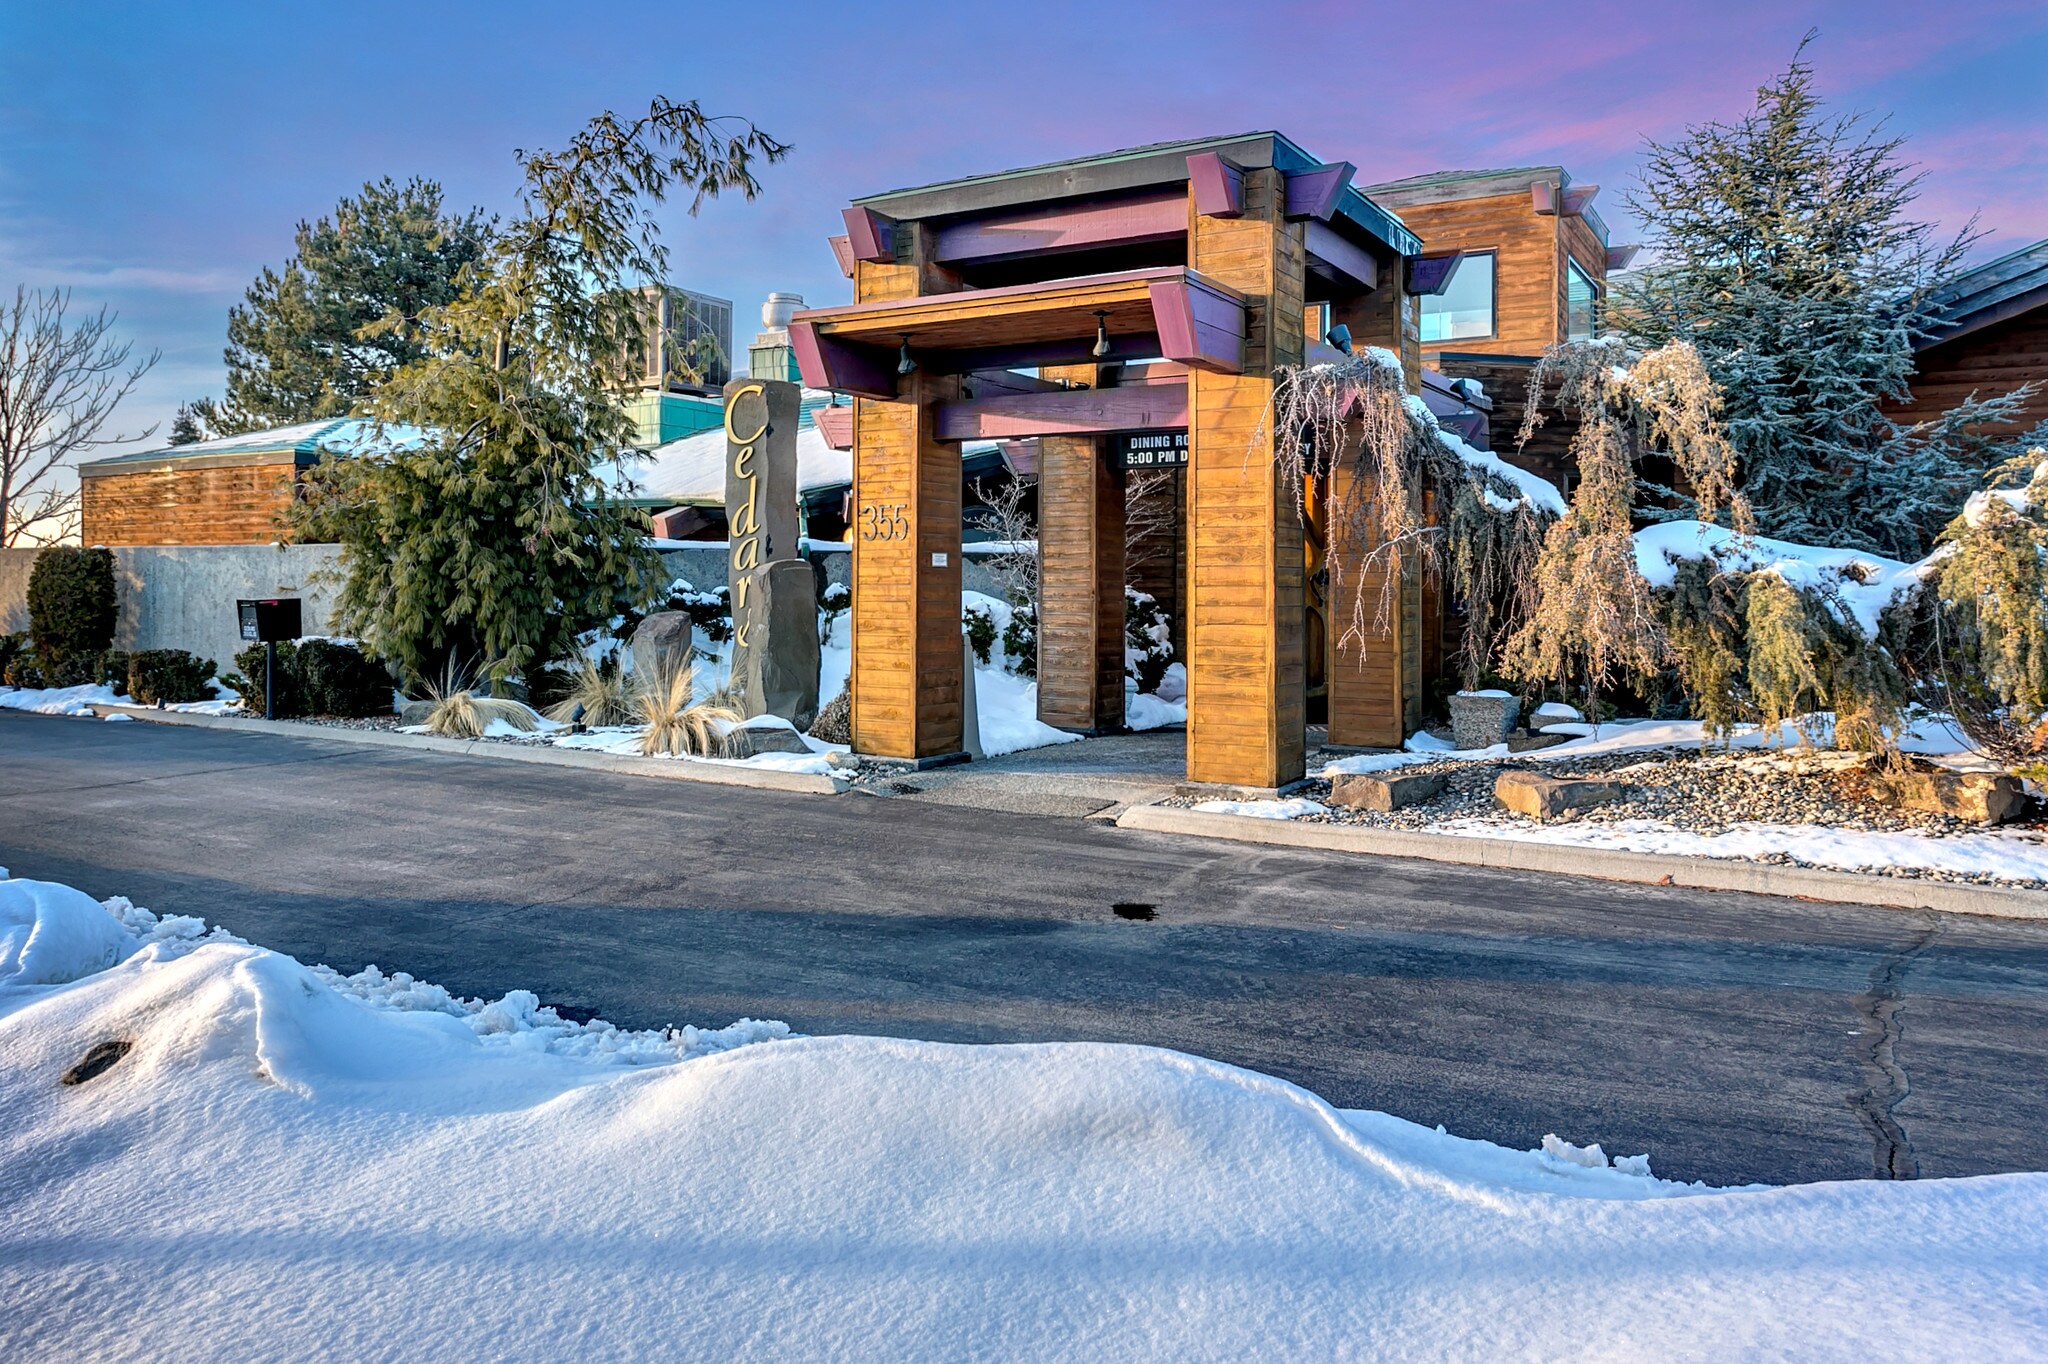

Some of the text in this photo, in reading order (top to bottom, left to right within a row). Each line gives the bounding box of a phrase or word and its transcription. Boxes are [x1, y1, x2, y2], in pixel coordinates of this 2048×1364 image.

[1130, 434, 1189, 449] DINING RO
[1126, 451, 1153, 465] 5:00
[1157, 450, 1176, 463] PM
[862, 504, 908, 541] 355
